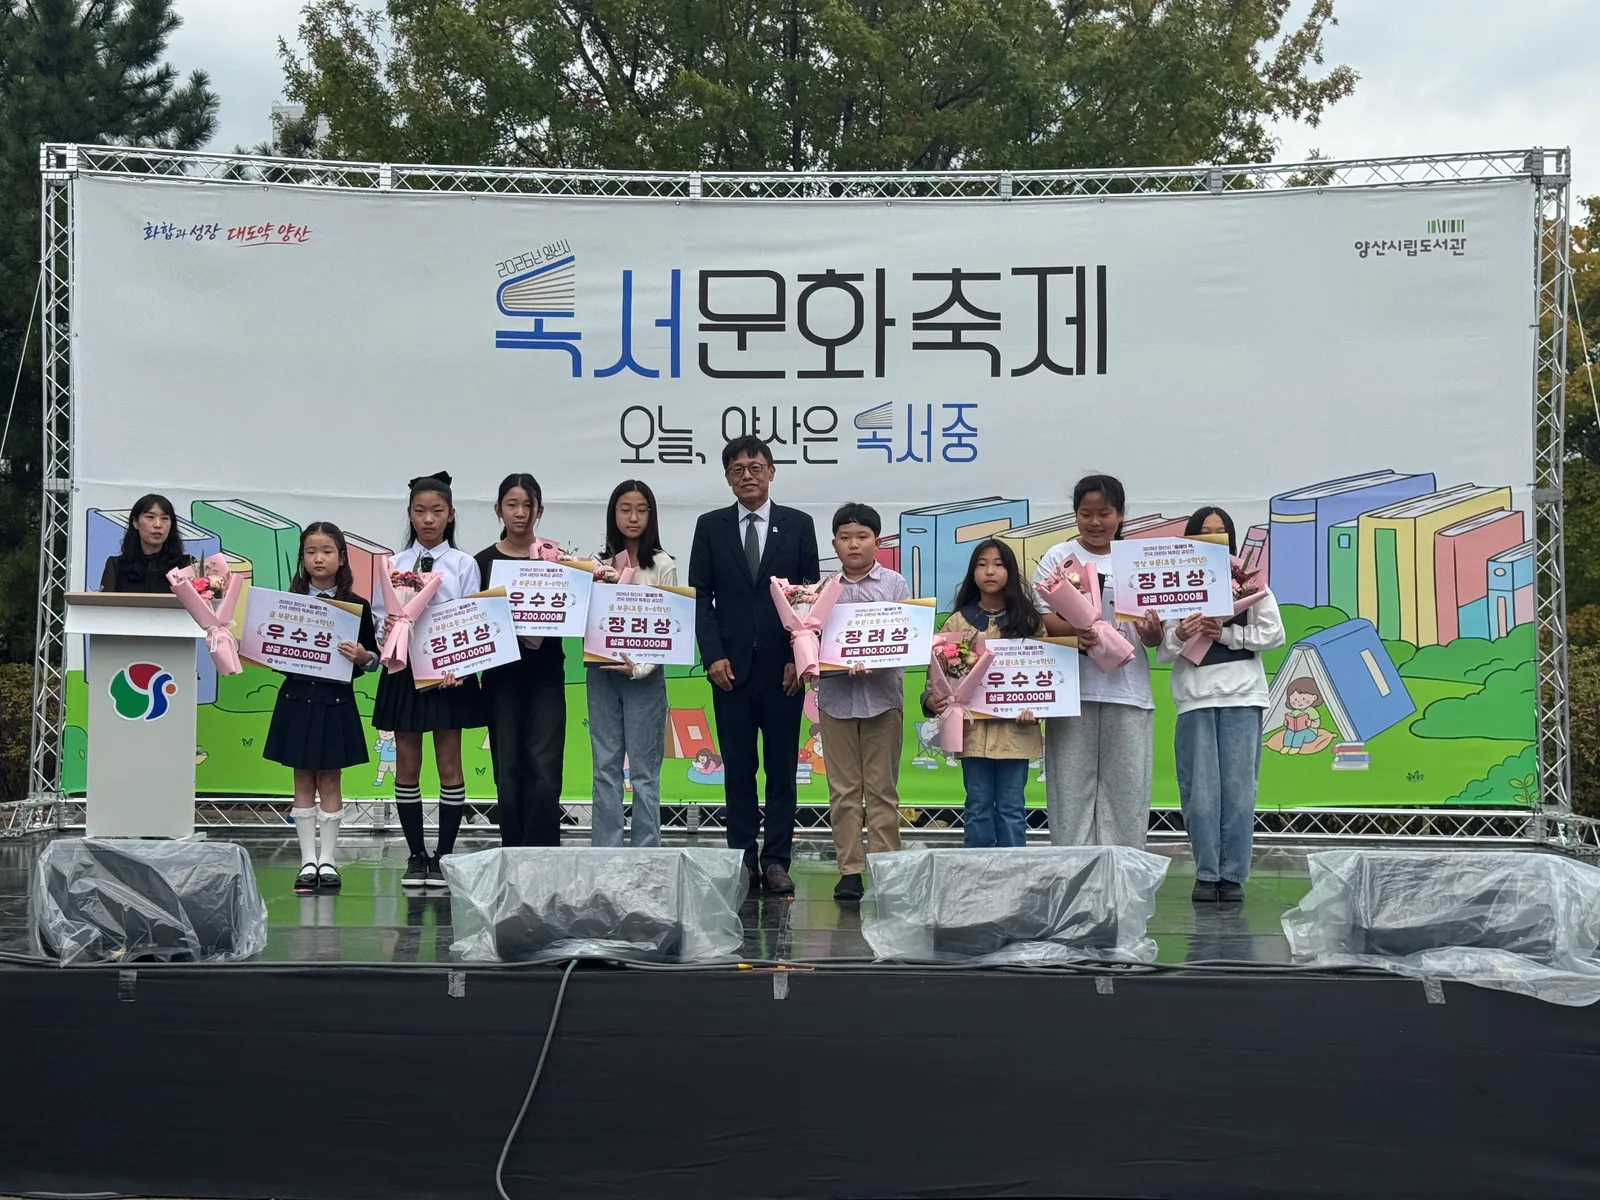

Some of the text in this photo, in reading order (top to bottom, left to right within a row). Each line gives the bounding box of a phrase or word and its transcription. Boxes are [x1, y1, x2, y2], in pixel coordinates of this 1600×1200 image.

[143, 221, 313, 243] 화합과 성장 대도약 양산
[1354, 238, 1467, 258] 양산시립도서관
[495, 238, 572, 278] 2026년 양산시
[495, 254, 1107, 379] 독서문화축제
[620, 405, 706, 464] 오늘,
[1138, 569, 1205, 590] 장려상
[509, 592, 567, 608] 우수상
[1142, 594, 1157, 604] 상금
[608, 616, 671, 635] 장려상
[266, 623, 333, 648] 우수상
[430, 623, 491, 654] 장려상
[610, 638, 625, 647] 상금
[845, 627, 909, 644] 장려상
[265, 644, 281, 654] 상금
[845, 648, 860, 656] 상금
[436, 655, 452, 667] 상금
[987, 670, 1054, 688] 우수상
[989, 694, 1005, 702] 상금
